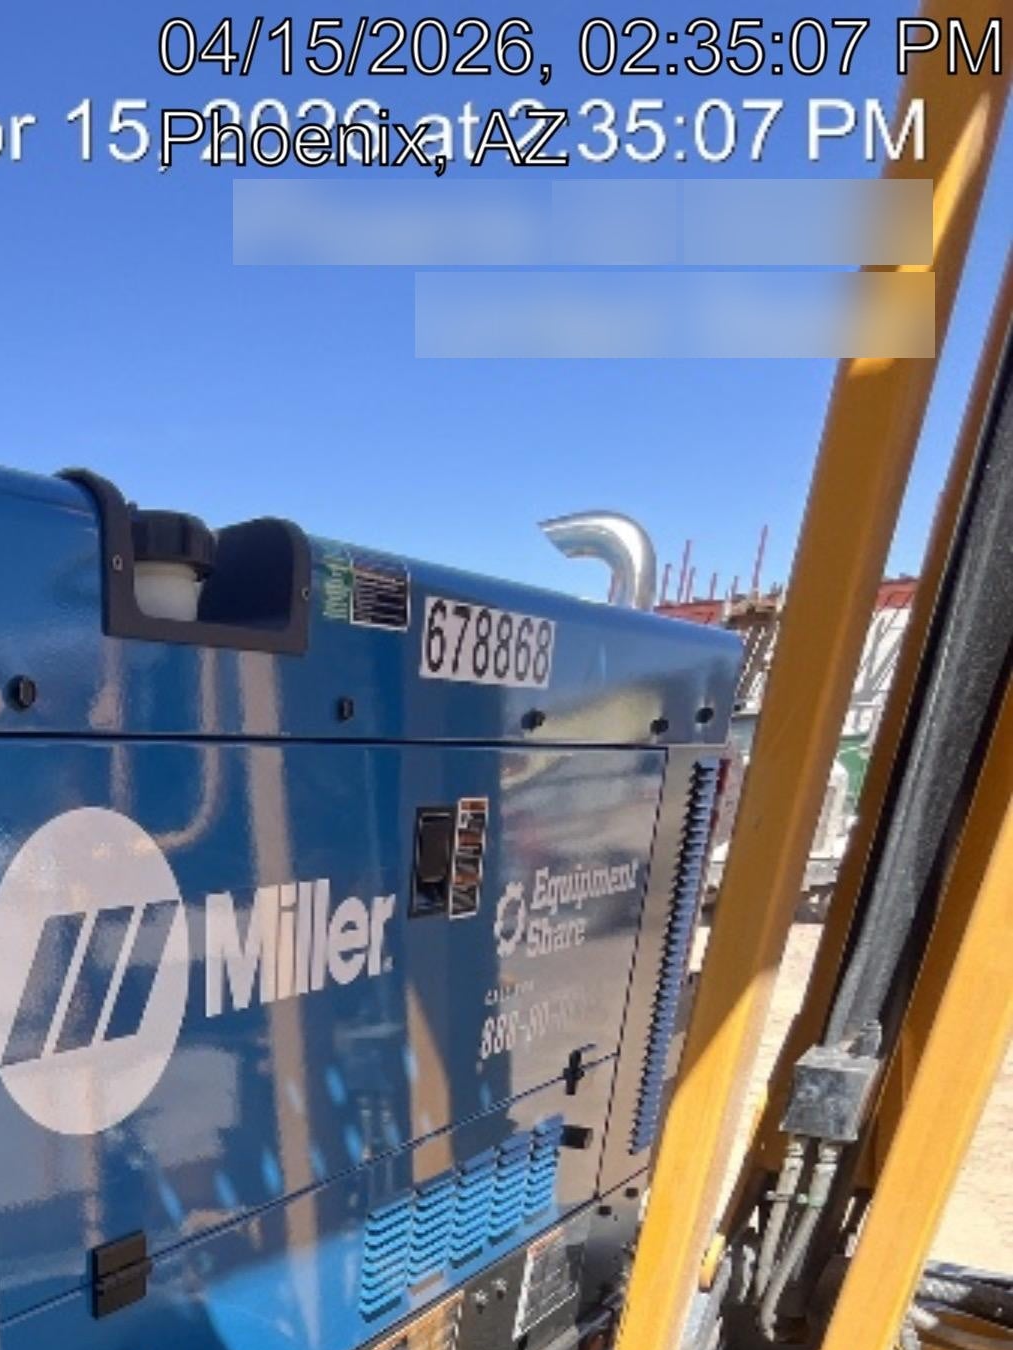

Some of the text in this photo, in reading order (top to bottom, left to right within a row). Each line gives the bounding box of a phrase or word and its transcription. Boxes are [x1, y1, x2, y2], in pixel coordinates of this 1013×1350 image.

[425, 600, 551, 683] 678868
[529, 858, 639, 916] Equipment
[526, 917, 587, 958] Share
